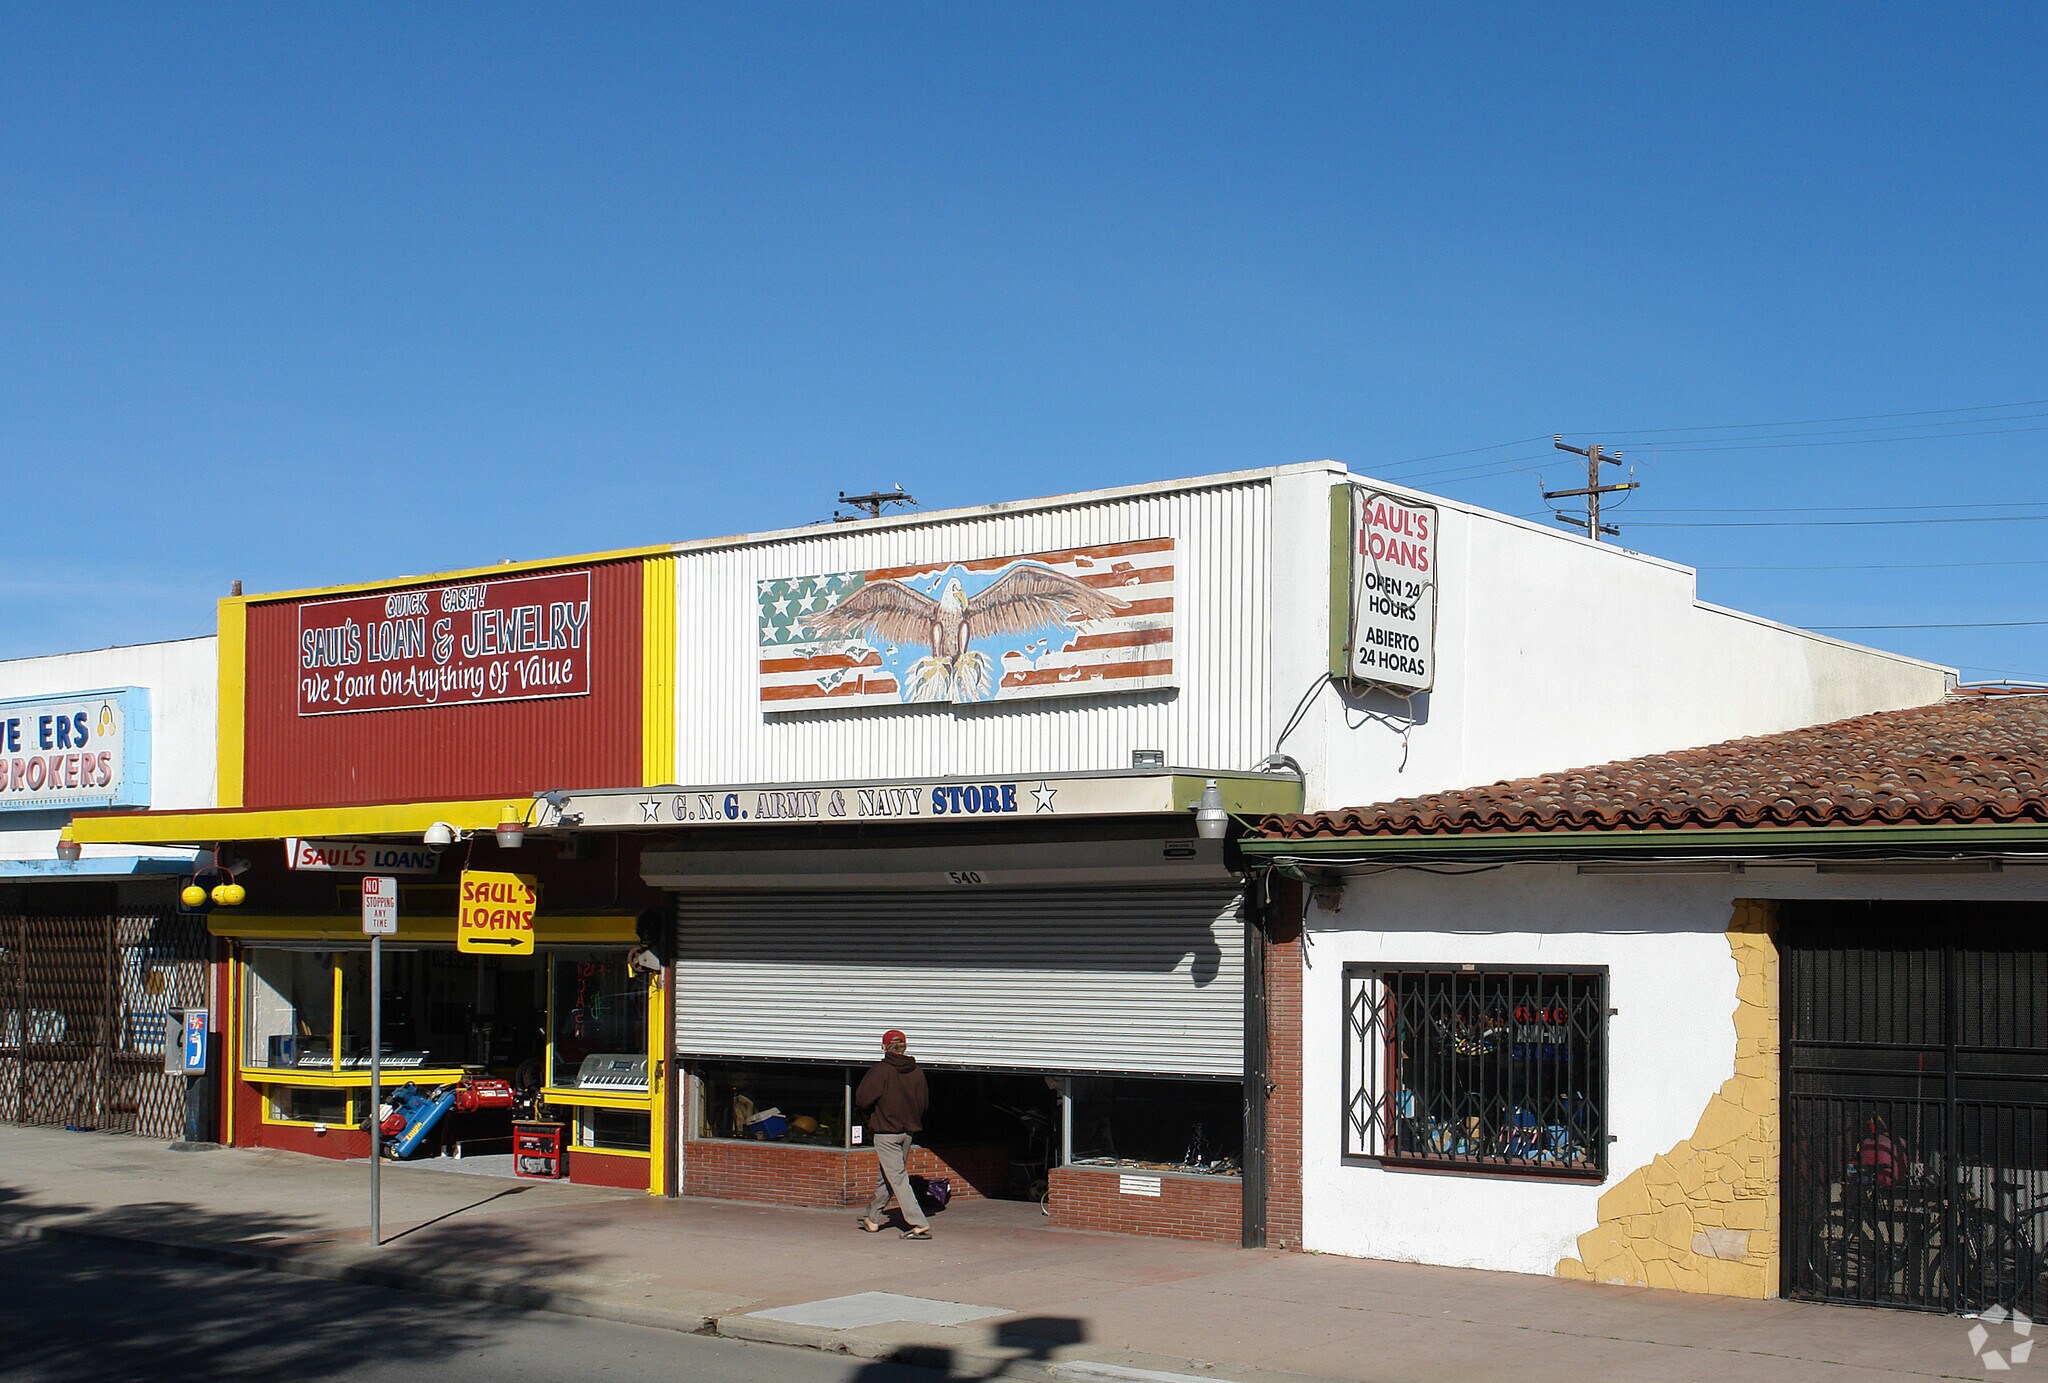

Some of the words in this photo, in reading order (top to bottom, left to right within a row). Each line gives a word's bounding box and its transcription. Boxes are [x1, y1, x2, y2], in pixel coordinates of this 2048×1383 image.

[1361, 501, 1429, 541] SAUL'S
[1358, 529, 1429, 572] LOANS
[1365, 572, 1402, 597] OPEN
[1405, 580, 1420, 600] 24
[385, 592, 429, 619] QUICK
[441, 584, 487, 612] CASH!
[1369, 595, 1416, 621] HOURS
[302, 617, 361, 669] SAUL'S
[368, 617, 425, 663] LOAN
[432, 618, 455, 664] &
[462, 601, 589, 659] JEWELRY
[1365, 626, 1420, 653] ABIERTO
[1359, 647, 1376, 666] 24
[1378, 651, 1425, 676] HORAS
[302, 671, 331, 703] We
[333, 670, 375, 704] Loan
[380, 669, 403, 695] On
[403, 661, 484, 703] Anything
[488, 659, 509, 695] Of
[514, 655, 573, 690] Value
[755, 791, 821, 819] ARMY
[827, 789, 846, 817] &
[857, 787, 922, 817] NAVY
[931, 784, 1018, 815] STORE
[301, 844, 366, 867] SAUL'S
[374, 850, 436, 869] LOANS
[366, 879, 378, 893] NO
[949, 871, 981, 884] 540
[366, 896, 394, 908] STOPPING
[463, 881, 536, 905] SAUL'S
[373, 909, 387, 918] ANY
[373, 918, 388, 928] TIME
[462, 907, 533, 931] LOANS
